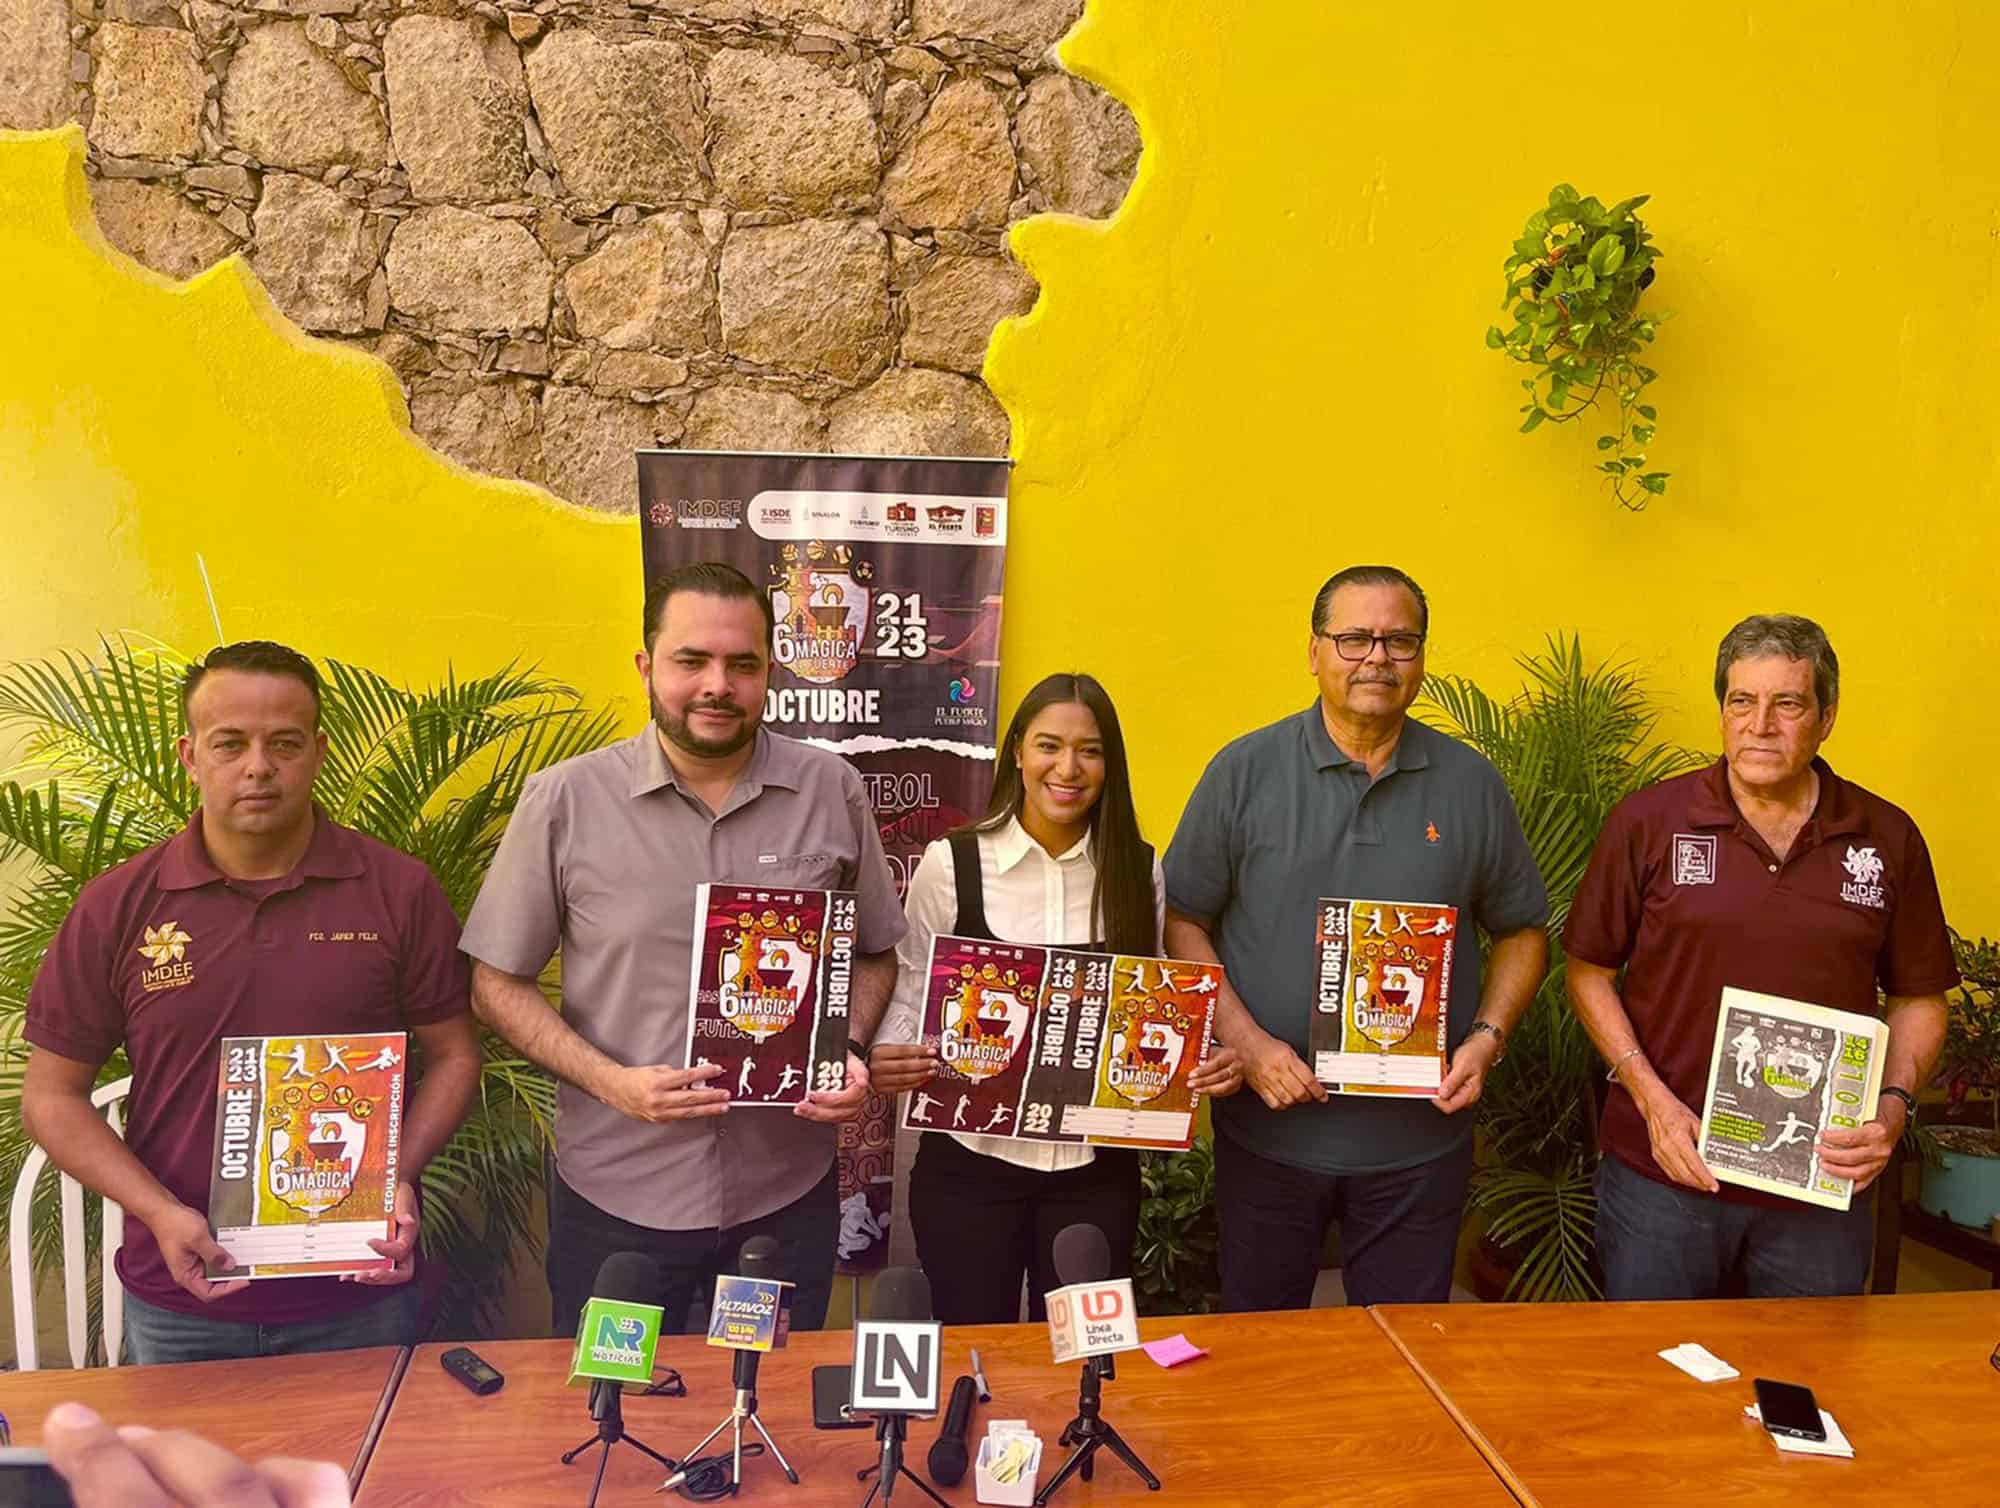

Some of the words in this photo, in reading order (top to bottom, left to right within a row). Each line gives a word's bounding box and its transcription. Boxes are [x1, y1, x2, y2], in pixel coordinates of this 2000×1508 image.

[876, 592, 927, 625] 21
[773, 623, 795, 664] 6
[876, 626, 927, 658] 23
[763, 688, 881, 723] OCTUBRE
[1842, 880, 1885, 898] IMDEF
[833, 899, 856, 915] 14
[1325, 906, 1345, 921] 21
[832, 916, 855, 931] 16
[1323, 920, 1345, 936] 23
[142, 961, 193, 984] IMDEF
[1053, 957, 1077, 974] 14
[1086, 961, 1108, 976] 21
[1318, 939, 1343, 1013] OCTUBRE
[826, 936, 852, 1018] OCTUBRE
[1050, 973, 1075, 989] 16
[1083, 976, 1107, 991] 23
[719, 981, 740, 1018] 6
[740, 998, 795, 1016] MAGICA
[1353, 999, 1369, 1030] 6
[1369, 1013, 1412, 1028] MAGICA
[1039, 992, 1071, 1067] OCTUBRE
[1071, 995, 1102, 1069] OCTUBRE
[941, 1028, 960, 1061] 6
[960, 1044, 1011, 1063] MAGICA
[229, 1047, 258, 1065] 21
[227, 1064, 257, 1082] 23
[816, 1060, 845, 1078] 20
[1108, 1056, 1124, 1086] 6
[1124, 1071, 1169, 1087] MAGICA
[1025, 1102, 1053, 1118] 20
[220, 1086, 253, 1180] OCTUBRE
[1023, 1118, 1051, 1134] 22
[387, 1149, 398, 1165] DE
[269, 1158, 291, 1196] 6
[291, 1170, 351, 1191] MAGICA
[718, 1299, 775, 1316] ALTAVOZ
[1087, 1333, 1124, 1346] Directa
[592, 1350, 641, 1364] NOTICIAS
[861, 1332, 932, 1399] LN
